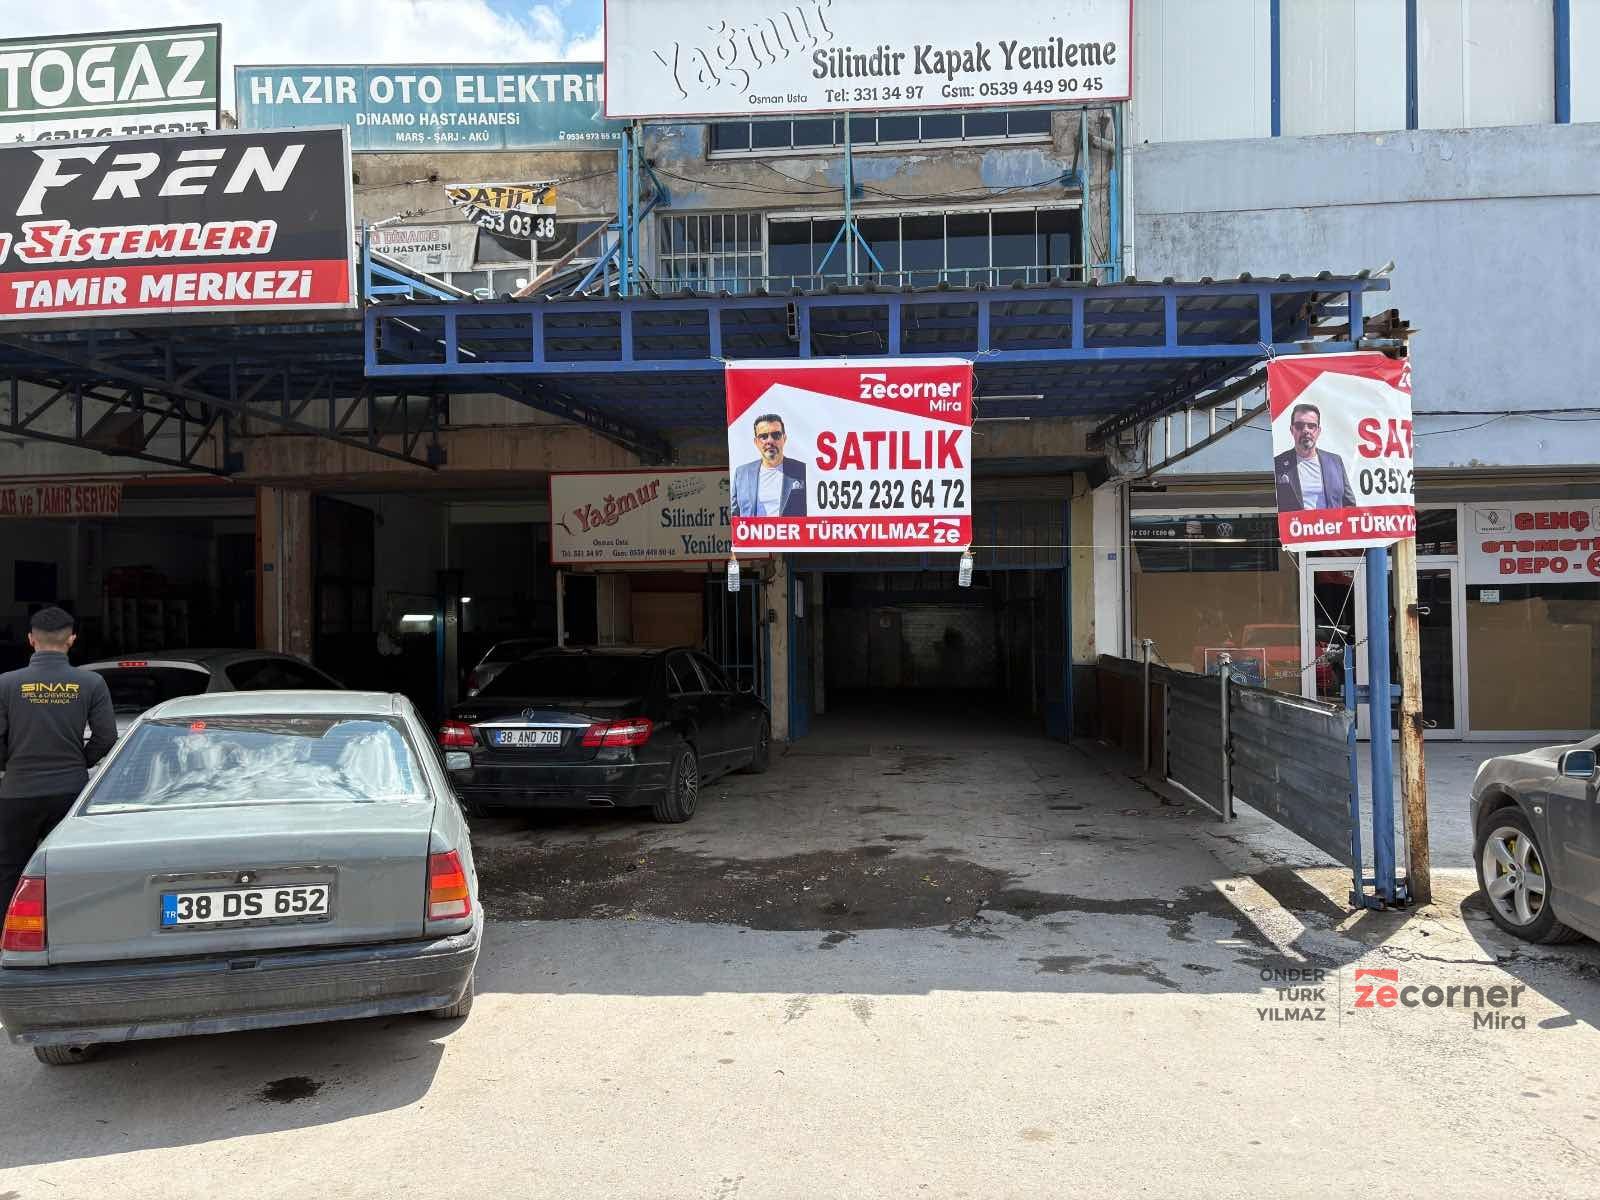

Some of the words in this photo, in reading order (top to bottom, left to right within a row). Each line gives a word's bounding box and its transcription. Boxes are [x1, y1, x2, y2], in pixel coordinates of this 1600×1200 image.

[812, 44, 905, 79] Silindir
[914, 41, 991, 81] Kapak
[999, 37, 1116, 71] Yenileme
[250, 75, 358, 105] HAZIR
[369, 75, 443, 104] OTO
[749, 95, 784, 105] Osman
[787, 94, 808, 104] Usta
[825, 88, 849, 103] Tel:
[854, 87, 878, 102] 331
[882, 86, 901, 101] 34
[906, 85, 924, 100] 97
[941, 84, 975, 99] Gsm:
[980, 82, 1018, 97] 0539
[1023, 80, 1053, 94] 449
[1058, 79, 1078, 93] 90
[1083, 77, 1103, 91] 45
[356, 112, 415, 126] DİNAMO
[419, 112, 520, 126] HASTAHANESİ
[396, 132, 425, 144] MARŞ
[433, 132, 458, 144] ŞARJ
[468, 130, 489, 142] AKÜ
[16, 144, 306, 216] FREN
[509, 214, 531, 237] 03
[535, 216, 554, 238] 38
[12, 276, 126, 308] TAMİR
[140, 270, 313, 302] MERKEZİ
[859, 381, 962, 399] zecorner
[929, 399, 962, 412] Mira
[816, 430, 964, 473] SATILIK
[816, 480, 863, 510] 0352
[869, 480, 905, 509] 232
[911, 480, 935, 509] 64
[941, 479, 965, 508] 72
[573, 478, 661, 533] Yağmur
[660, 506, 715, 528] Silindir
[1514, 511, 1590, 532] GENÇ
[736, 520, 800, 541] ÖNDER
[806, 521, 930, 540] TÜRKYILMAZ
[1289, 518, 1343, 538] Önder
[1499, 556, 1569, 575] DEPO
[501, 731, 513, 743] 38
[540, 731, 559, 743] 706
[178, 896, 212, 920] 38
[222, 892, 263, 917] DS
[274, 888, 325, 914] 652
[166, 911, 176, 919] TR
